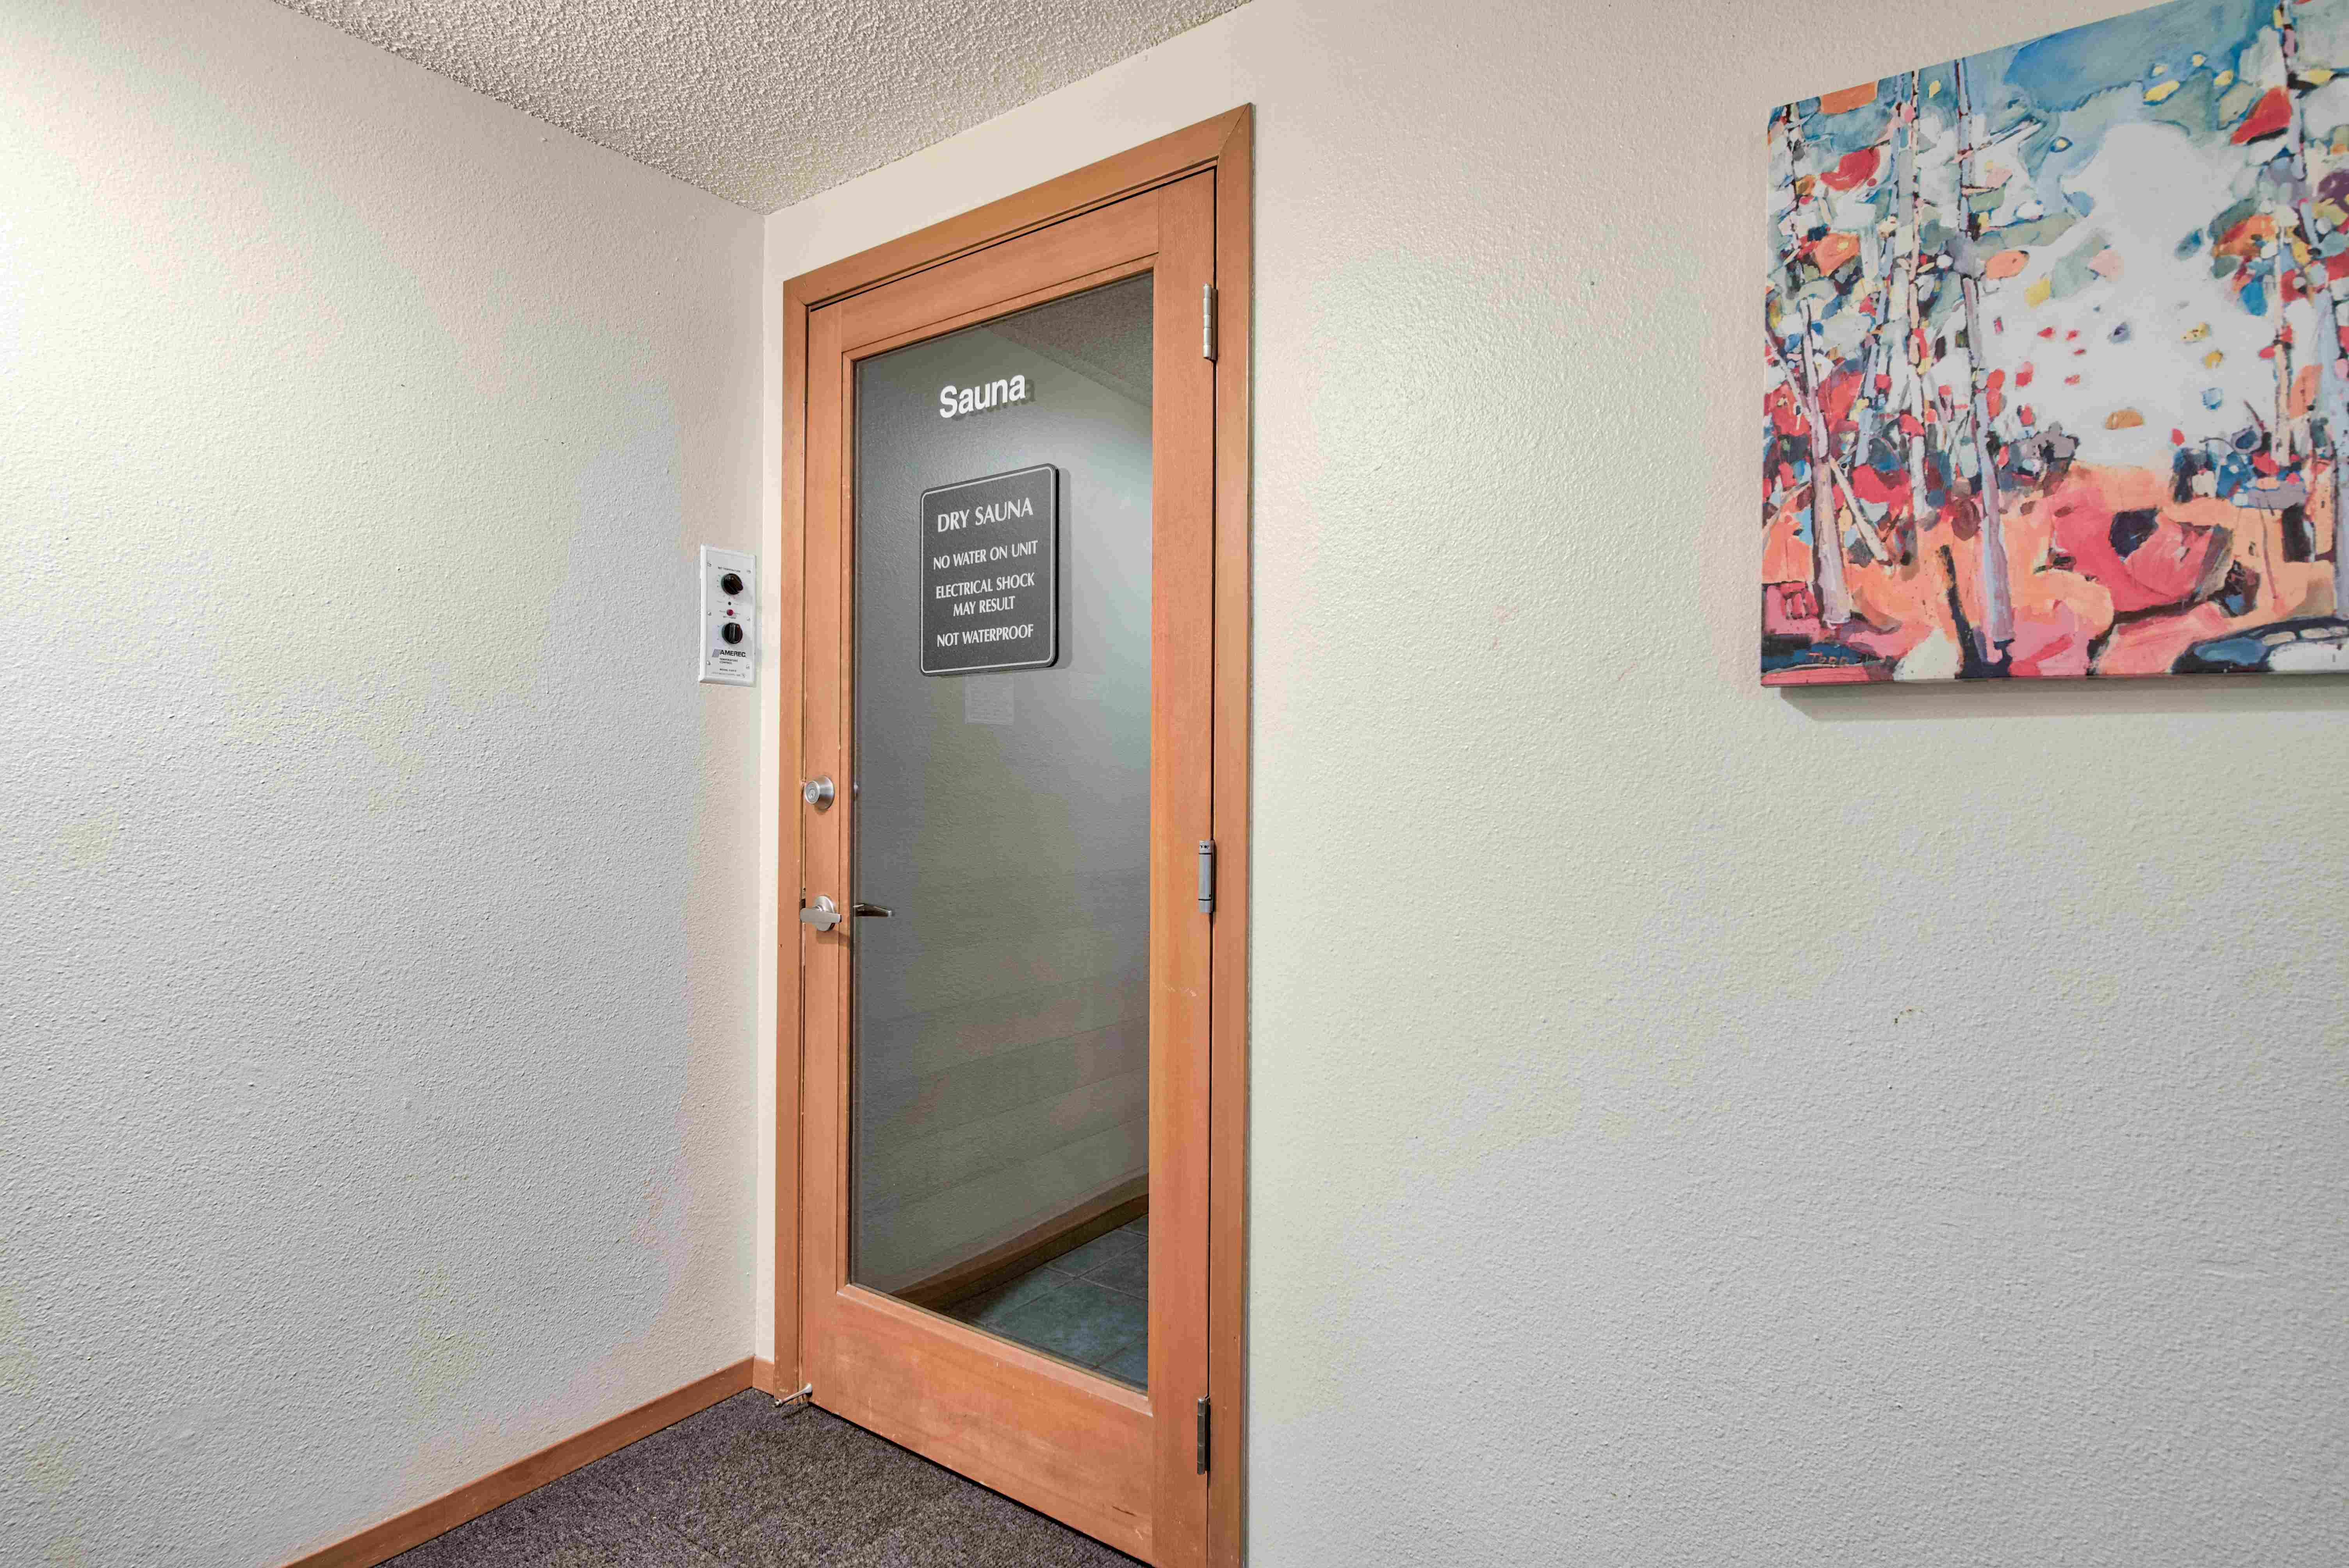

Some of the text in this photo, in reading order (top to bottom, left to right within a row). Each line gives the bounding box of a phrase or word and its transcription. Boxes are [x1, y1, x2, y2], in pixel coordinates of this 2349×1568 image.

[939, 374, 1027, 419] Sauna
[937, 497, 1034, 533] DRY SAUNA
[933, 540, 1039, 570] NO WATER ON UNIT
[936, 572, 1035, 599] ELECTRICAL SHOCK
[953, 595, 1016, 617] MAY RESULT
[937, 623, 1034, 647] NOT WATERPROOF
[720, 649, 746, 658] AMEREC
